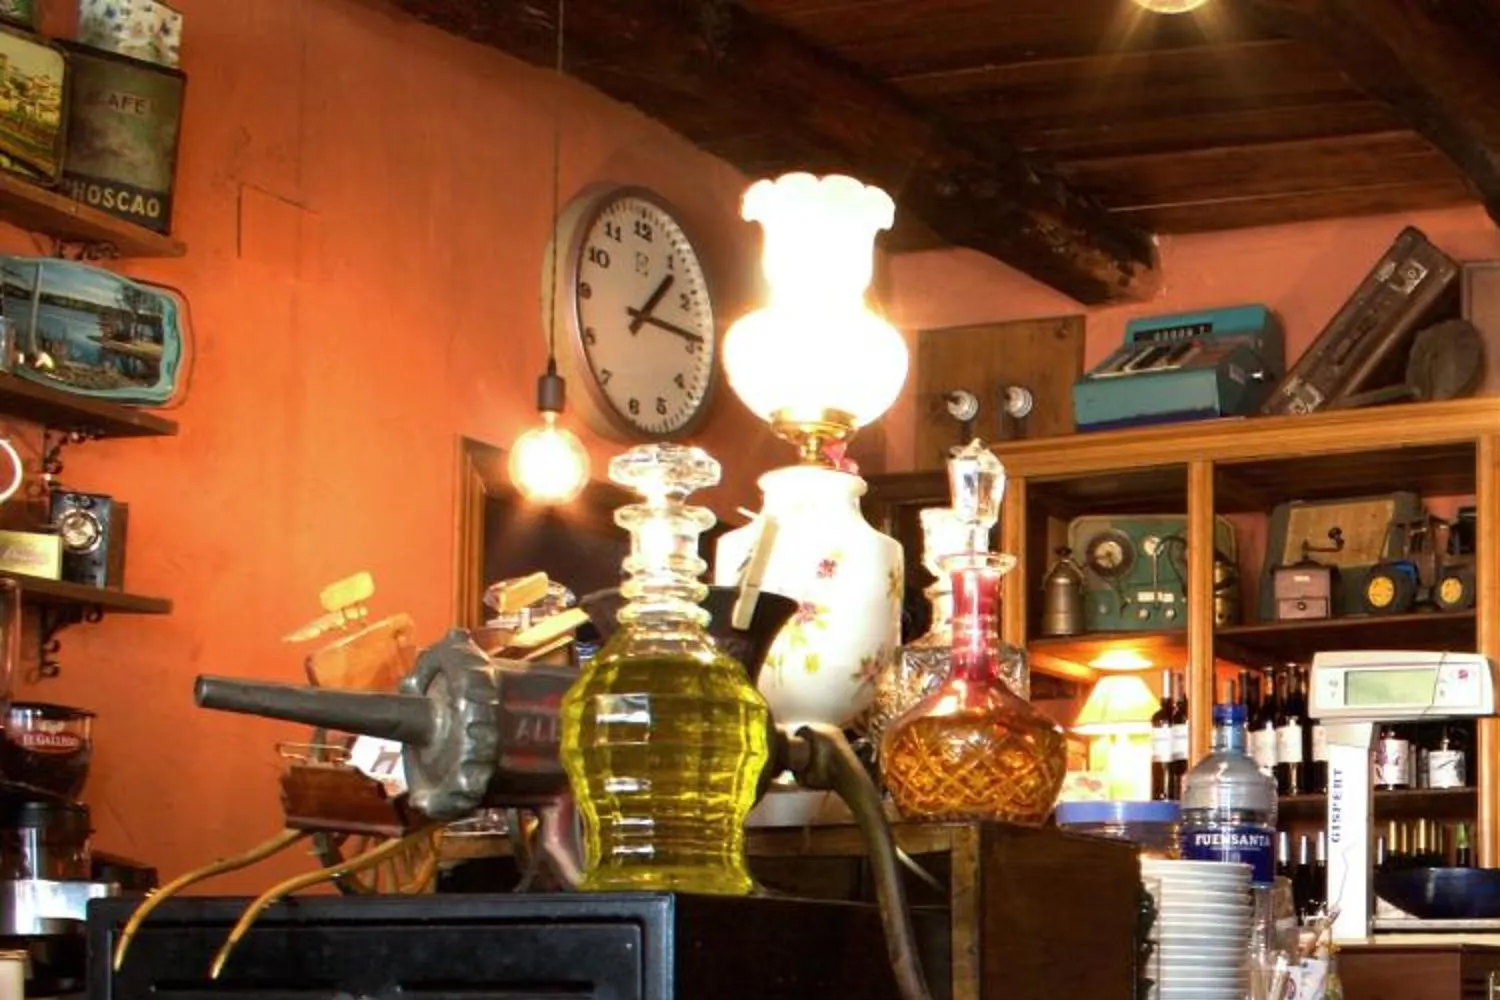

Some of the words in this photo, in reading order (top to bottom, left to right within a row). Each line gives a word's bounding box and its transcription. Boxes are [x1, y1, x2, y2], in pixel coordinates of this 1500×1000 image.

[604, 221, 622, 243] 11
[633, 220, 652, 242] 12
[588, 249, 611, 269] 10
[679, 293, 692, 312] 2
[601, 369, 613, 386] 7
[628, 398, 640, 416] 6
[656, 397, 667, 415] 5
[1194, 832, 1271, 847] FUENSANTA
